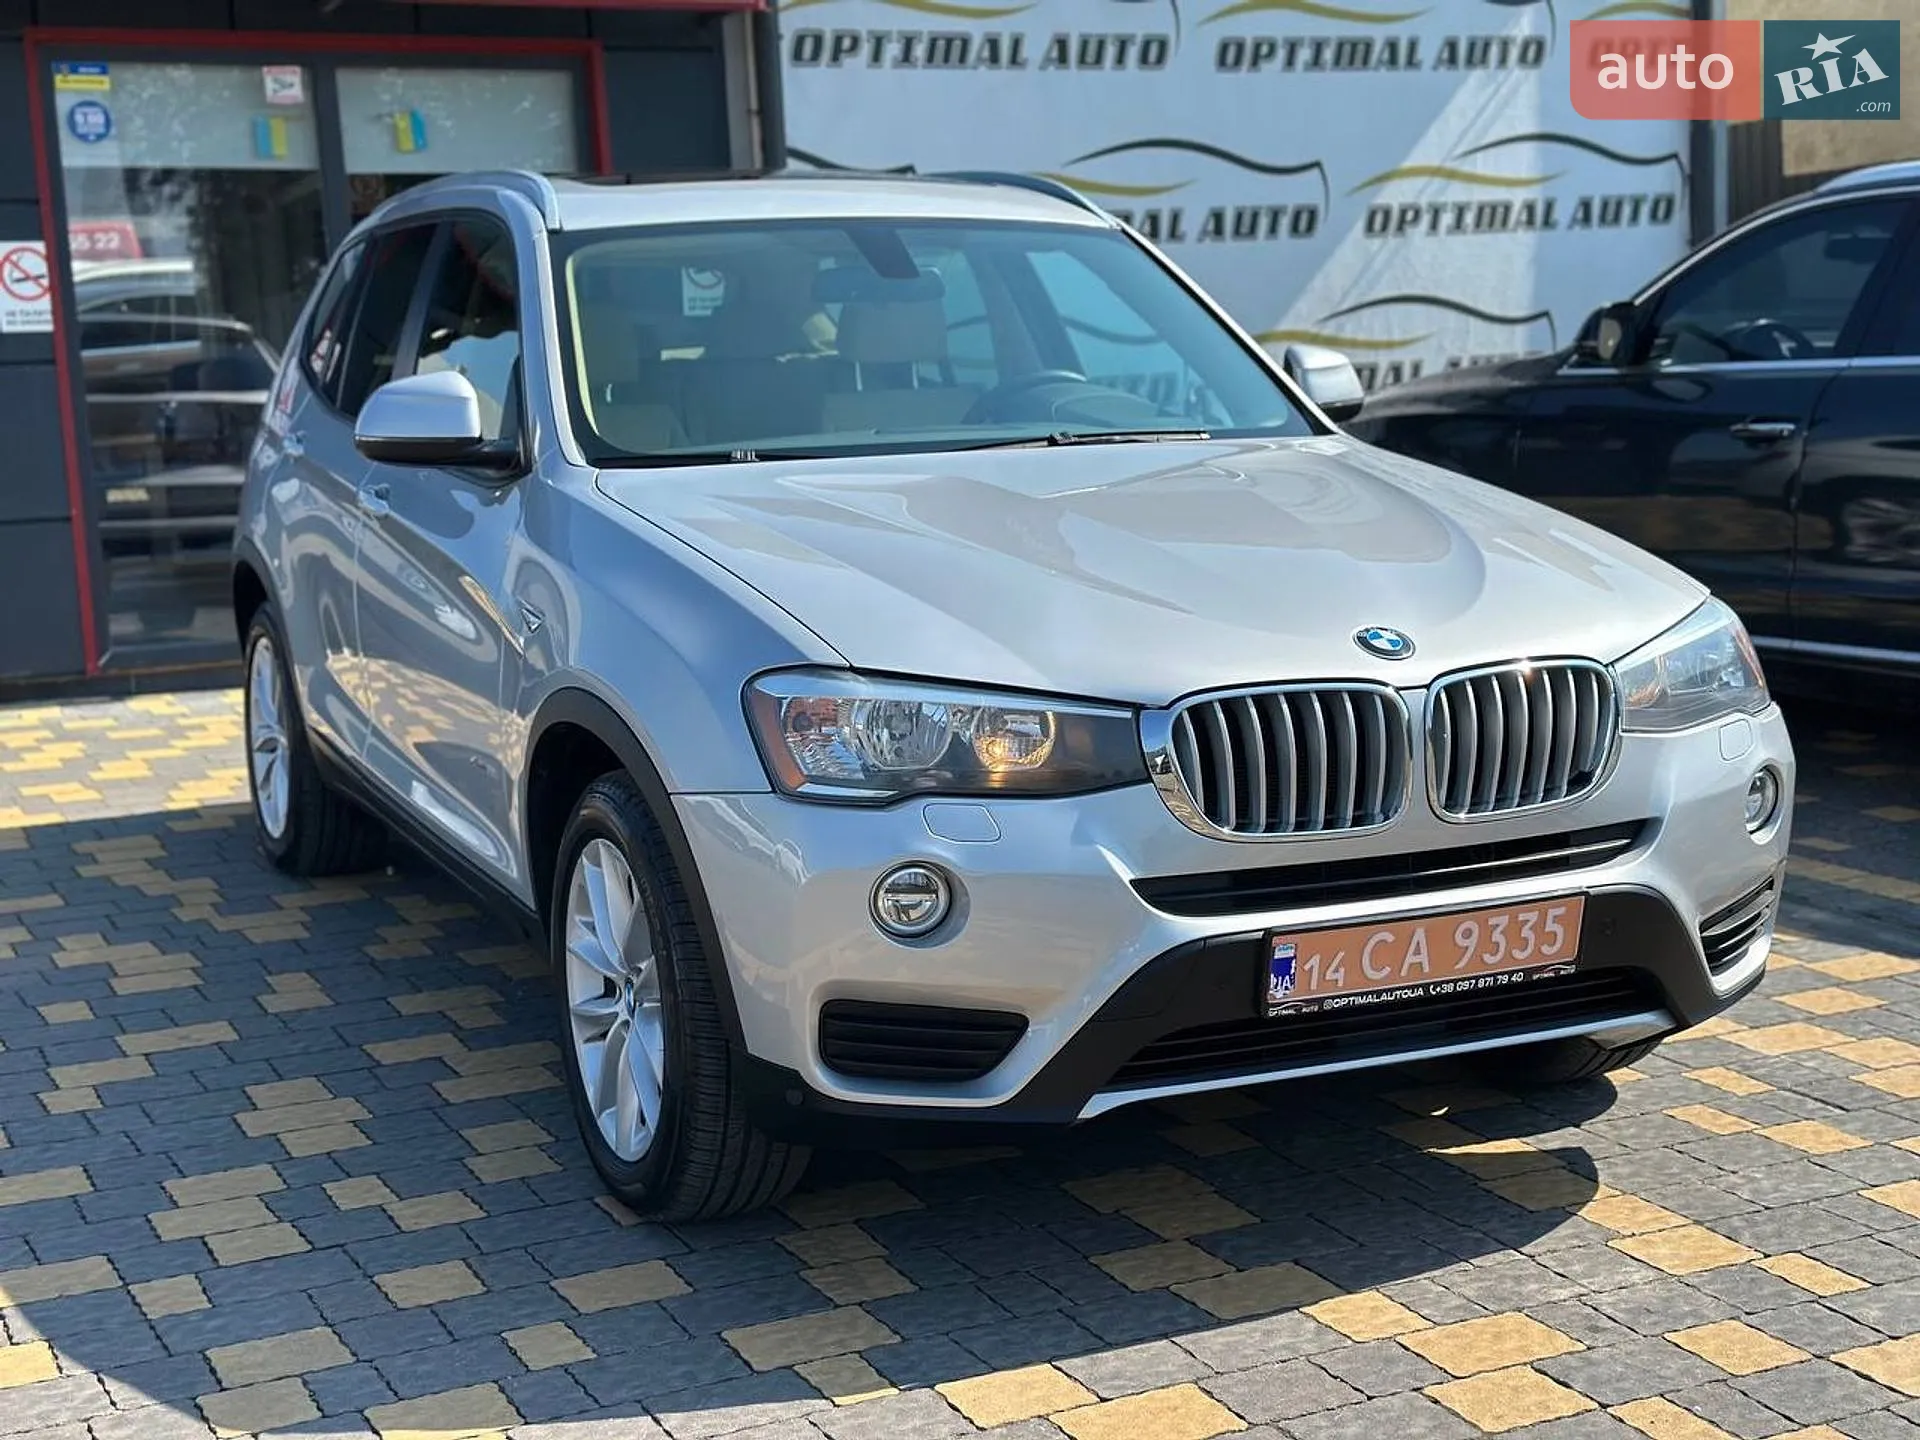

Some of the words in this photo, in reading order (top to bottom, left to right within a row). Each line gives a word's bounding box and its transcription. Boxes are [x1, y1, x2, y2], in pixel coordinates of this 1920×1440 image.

[789, 29, 1027, 69] OPTIMAL
[1039, 32, 1170, 71] AUTO
[1215, 35, 1422, 73] OPTIMAL
[1432, 35, 1547, 71] AUTO
[1197, 203, 1319, 243] AUTO
[1363, 196, 1560, 237] OPTIMAL
[1567, 192, 1680, 231] AUTO
[1303, 951, 1345, 990] 14
[1361, 927, 1430, 980] CA
[1454, 906, 1568, 970] 9335
[1456, 979, 1476, 991] 097
[1478, 977, 1494, 988] 871
[1497, 974, 1509, 985] 79
[1511, 972, 1524, 982] 40
